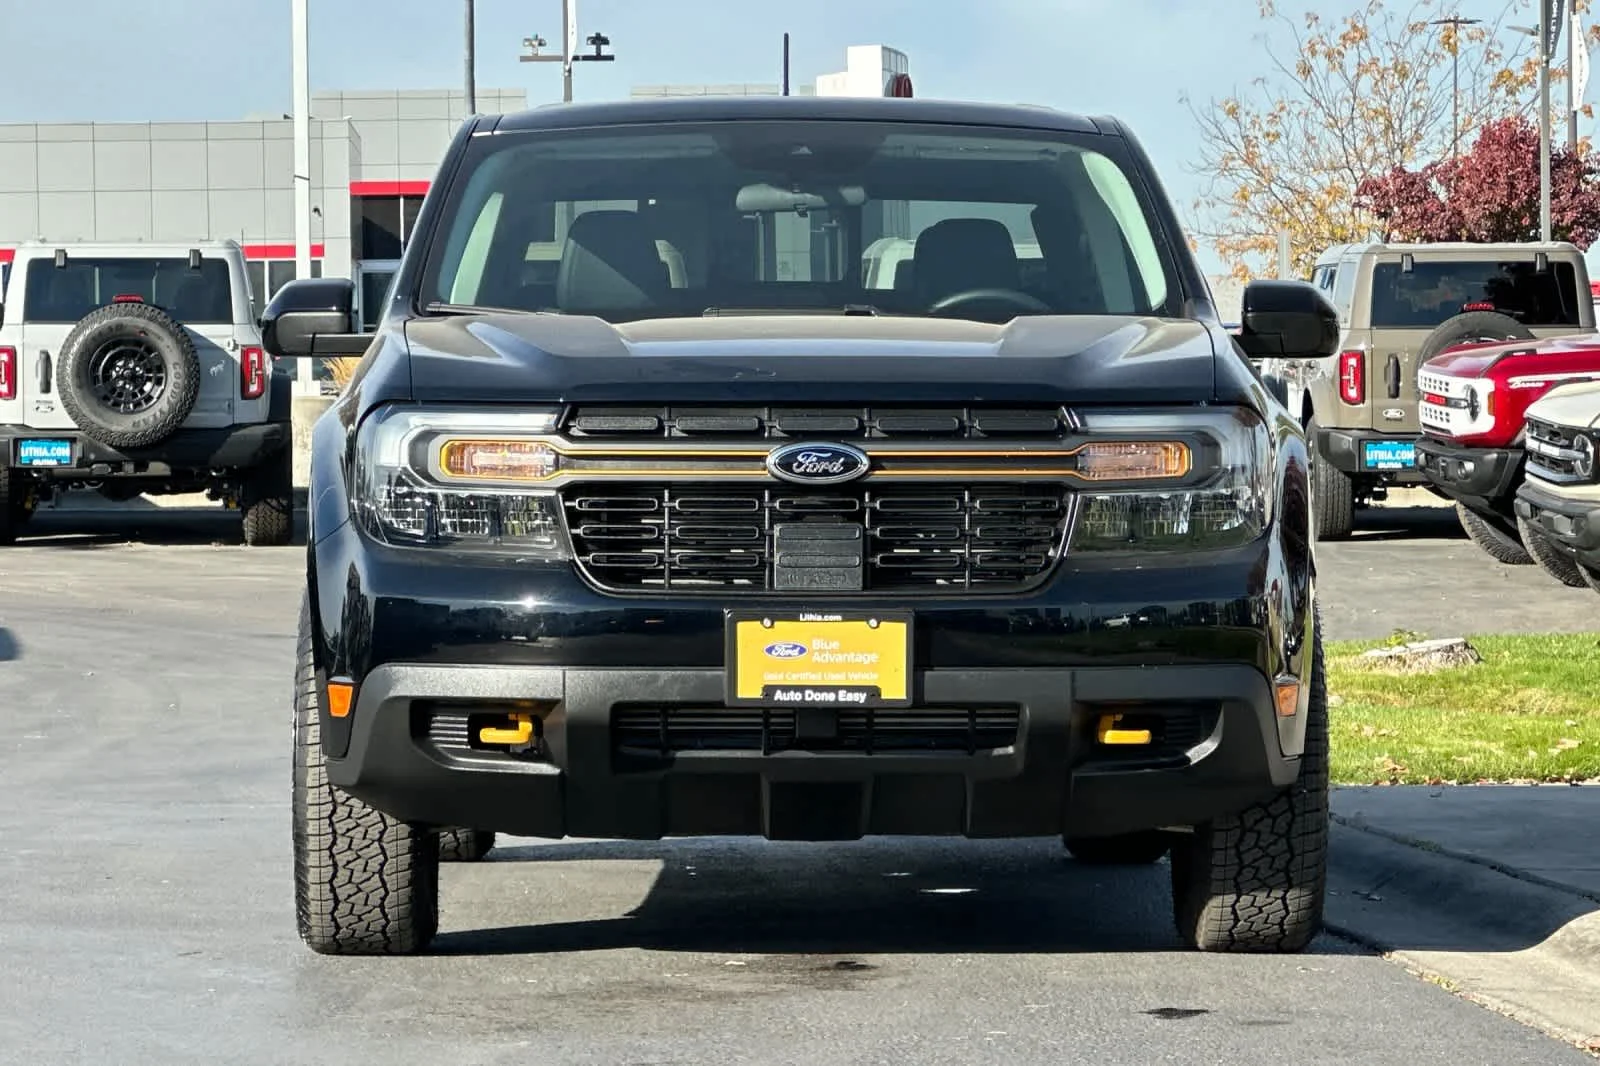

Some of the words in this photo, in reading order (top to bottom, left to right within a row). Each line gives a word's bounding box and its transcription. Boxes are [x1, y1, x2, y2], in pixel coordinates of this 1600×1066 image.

[21, 446, 70, 457] LITHIA.COM
[792, 451, 846, 473] Ford
[800, 613, 842, 622] Lithia.com
[771, 644, 801, 656] Ford
[811, 638, 840, 650] Blue
[811, 651, 879, 664] Advantage
[786, 671, 822, 681] Certified
[823, 671, 847, 681] Used
[847, 671, 879, 681] Vehicle
[774, 689, 803, 701] Auto
[804, 689, 836, 701] Done
[838, 689, 867, 703] Easy
